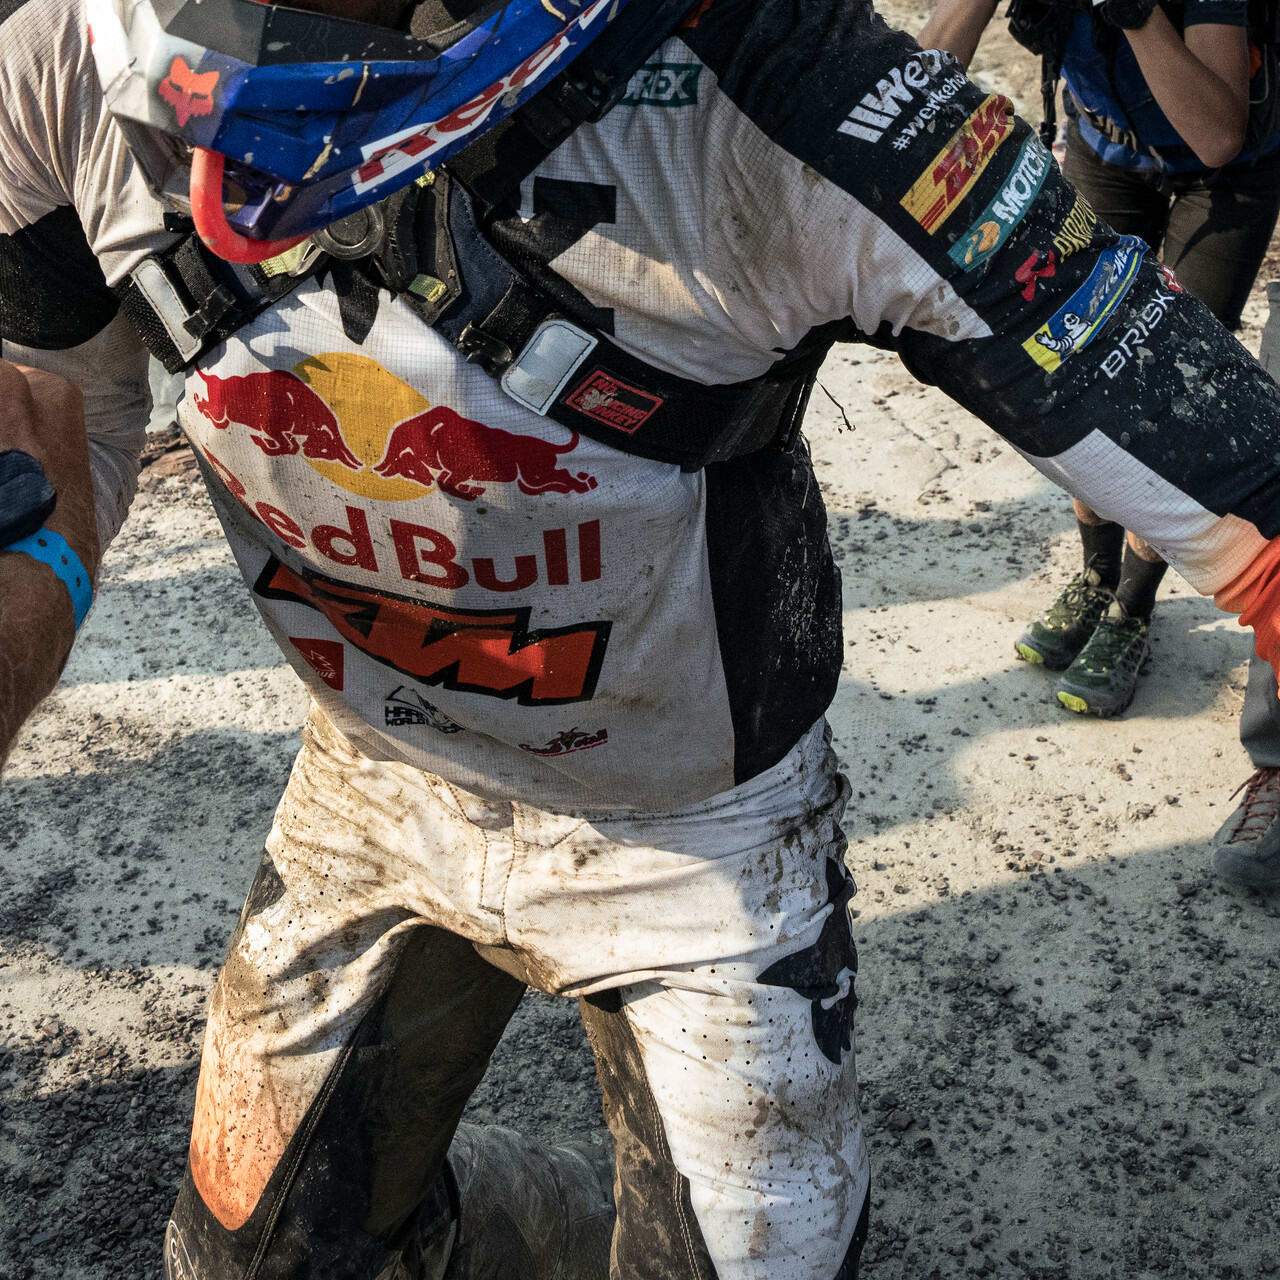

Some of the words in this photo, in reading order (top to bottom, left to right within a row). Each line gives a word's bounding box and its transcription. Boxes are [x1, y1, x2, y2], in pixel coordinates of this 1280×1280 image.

[1099, 288, 1177, 380] BRISK
[389, 519, 602, 593] Bull
[253, 552, 614, 707] KTM
